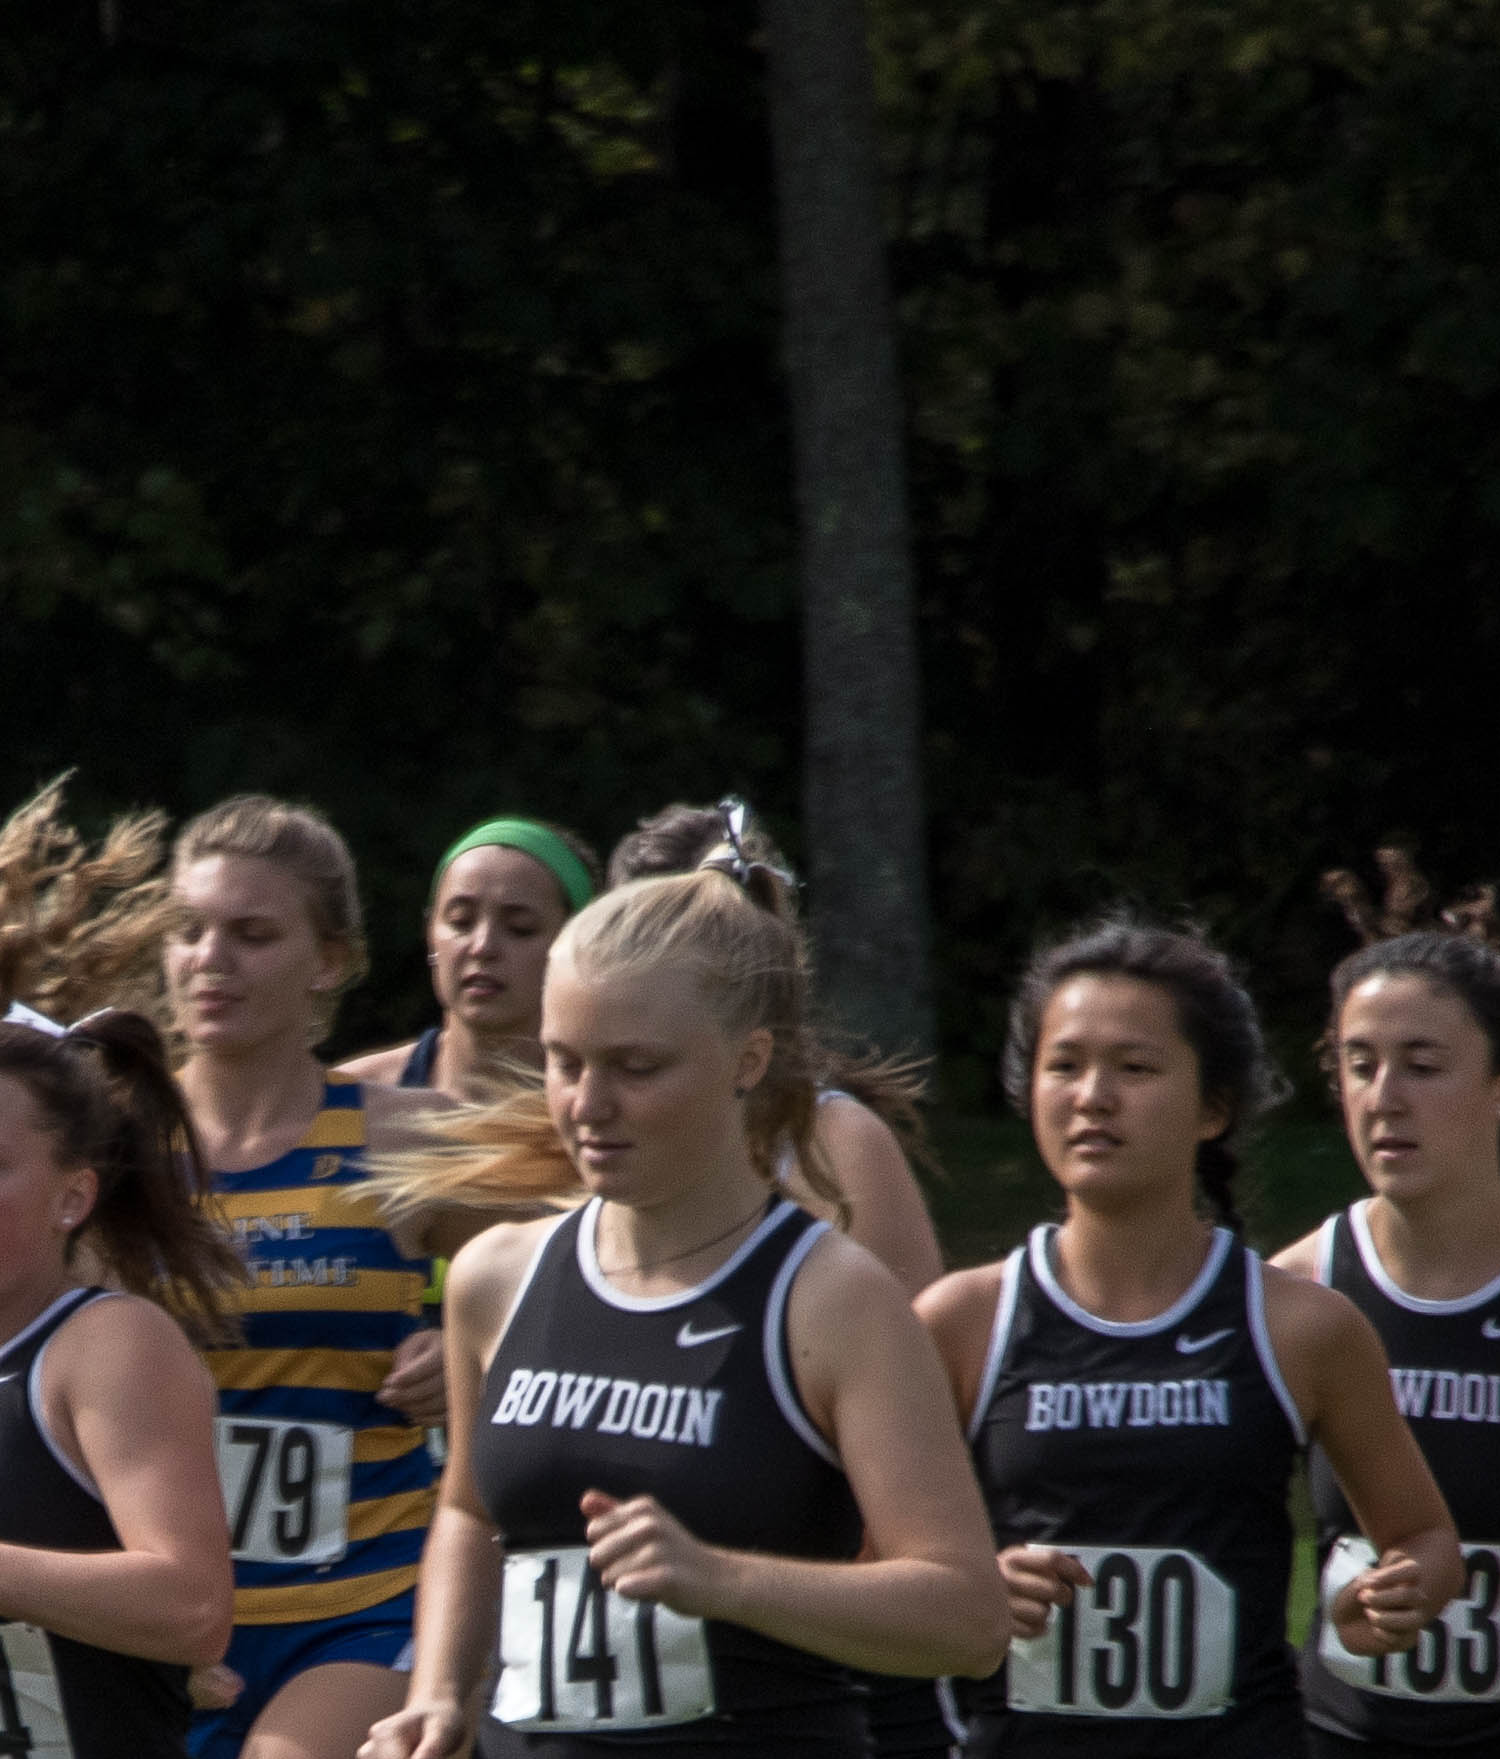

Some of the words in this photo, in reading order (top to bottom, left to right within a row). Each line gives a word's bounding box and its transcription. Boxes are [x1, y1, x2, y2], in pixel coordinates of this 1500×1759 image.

[492, 1369, 725, 1446] BOWDOIN
[1024, 1378, 1231, 1433] BOWDOIN
[230, 1426, 316, 1556] 79
[534, 1557, 666, 1721] 141
[1058, 1553, 1196, 1710] 130
